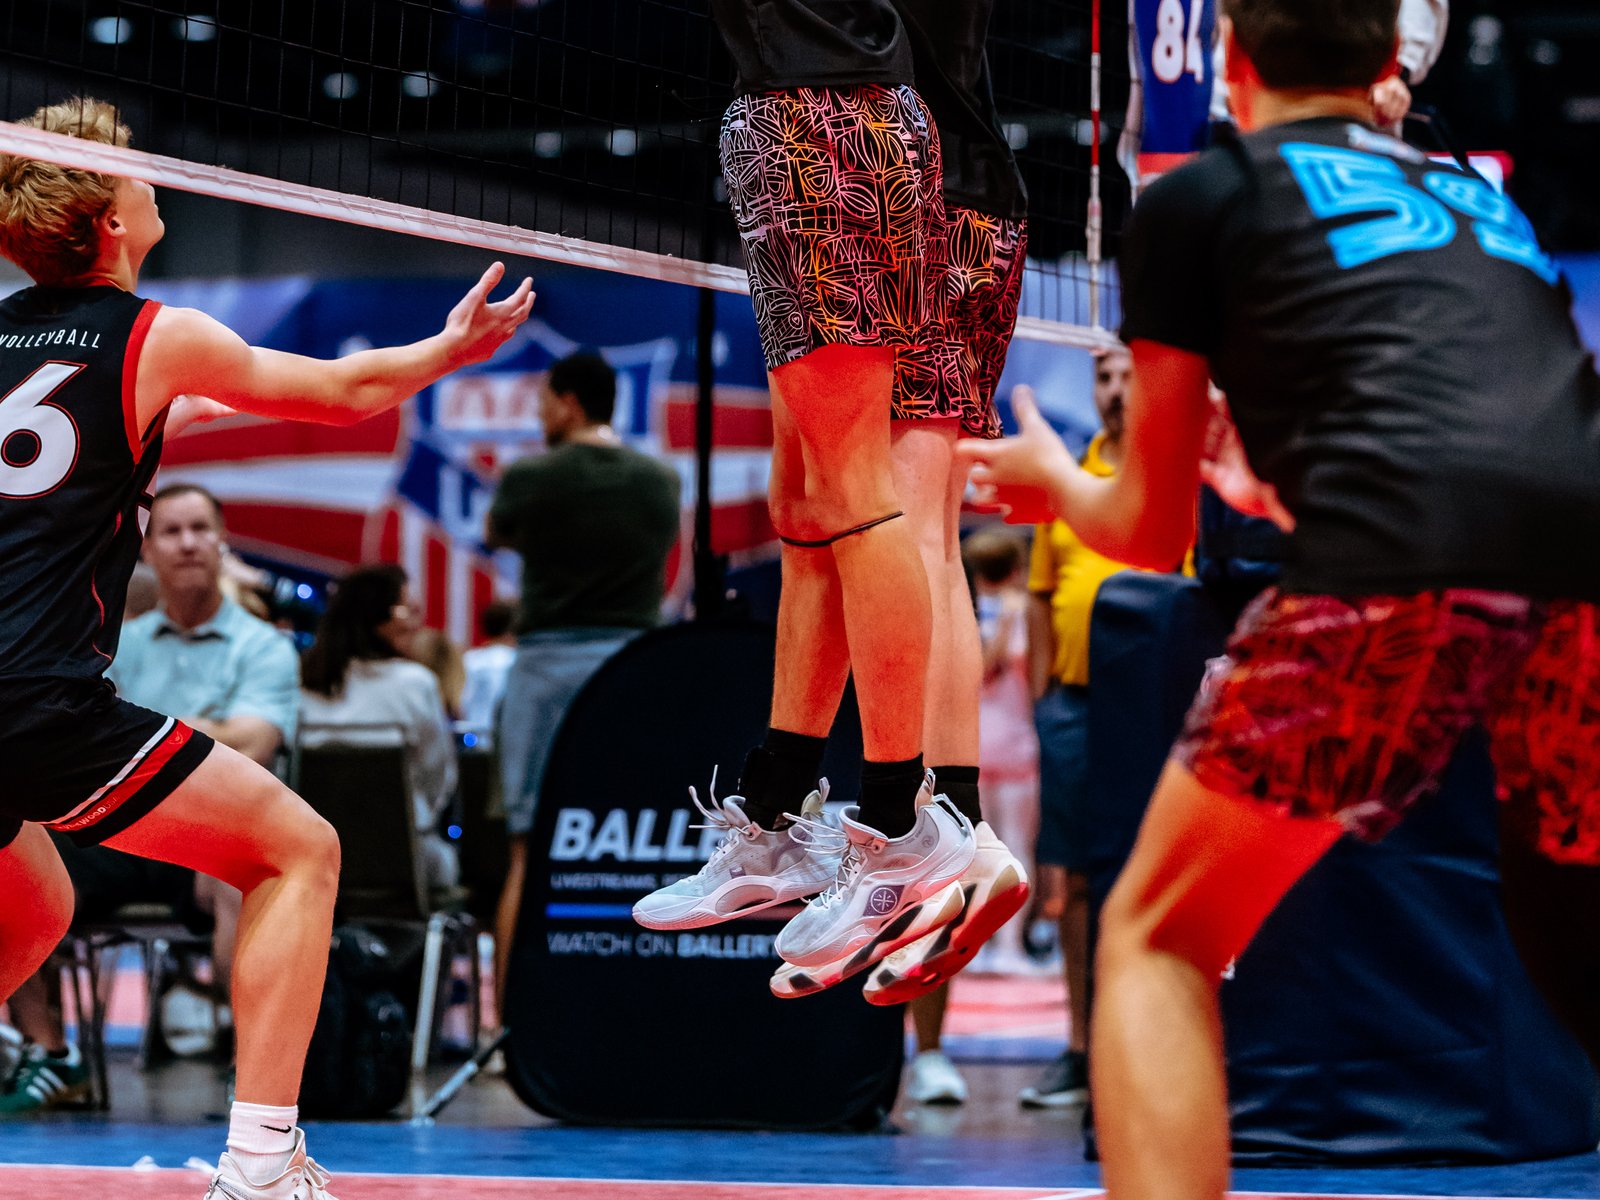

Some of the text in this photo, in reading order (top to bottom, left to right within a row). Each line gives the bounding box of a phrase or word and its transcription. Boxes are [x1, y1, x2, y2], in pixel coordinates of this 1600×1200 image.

[0, 328, 100, 349] VOLLEYBALL
[0, 360, 88, 499] 6
[549, 807, 730, 862] BALLE
[547, 931, 632, 955] WATCH
[635, 933, 675, 956] ON
